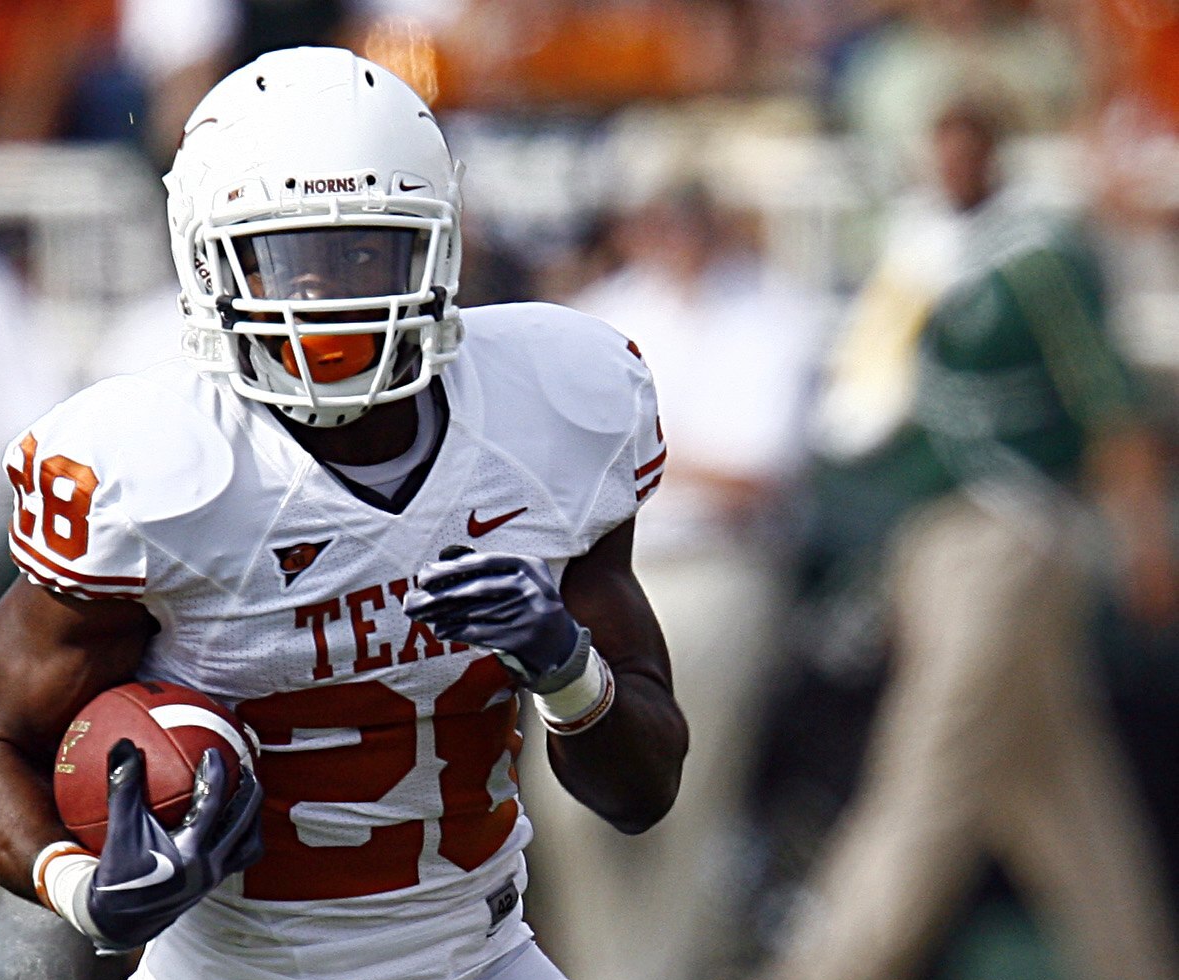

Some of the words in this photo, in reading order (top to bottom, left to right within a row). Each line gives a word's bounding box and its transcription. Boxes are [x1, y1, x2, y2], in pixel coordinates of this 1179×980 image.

[304, 177, 356, 194] HORNS
[6, 430, 100, 562] 28
[295, 575, 470, 681] TEX
[235, 652, 524, 902] 28
